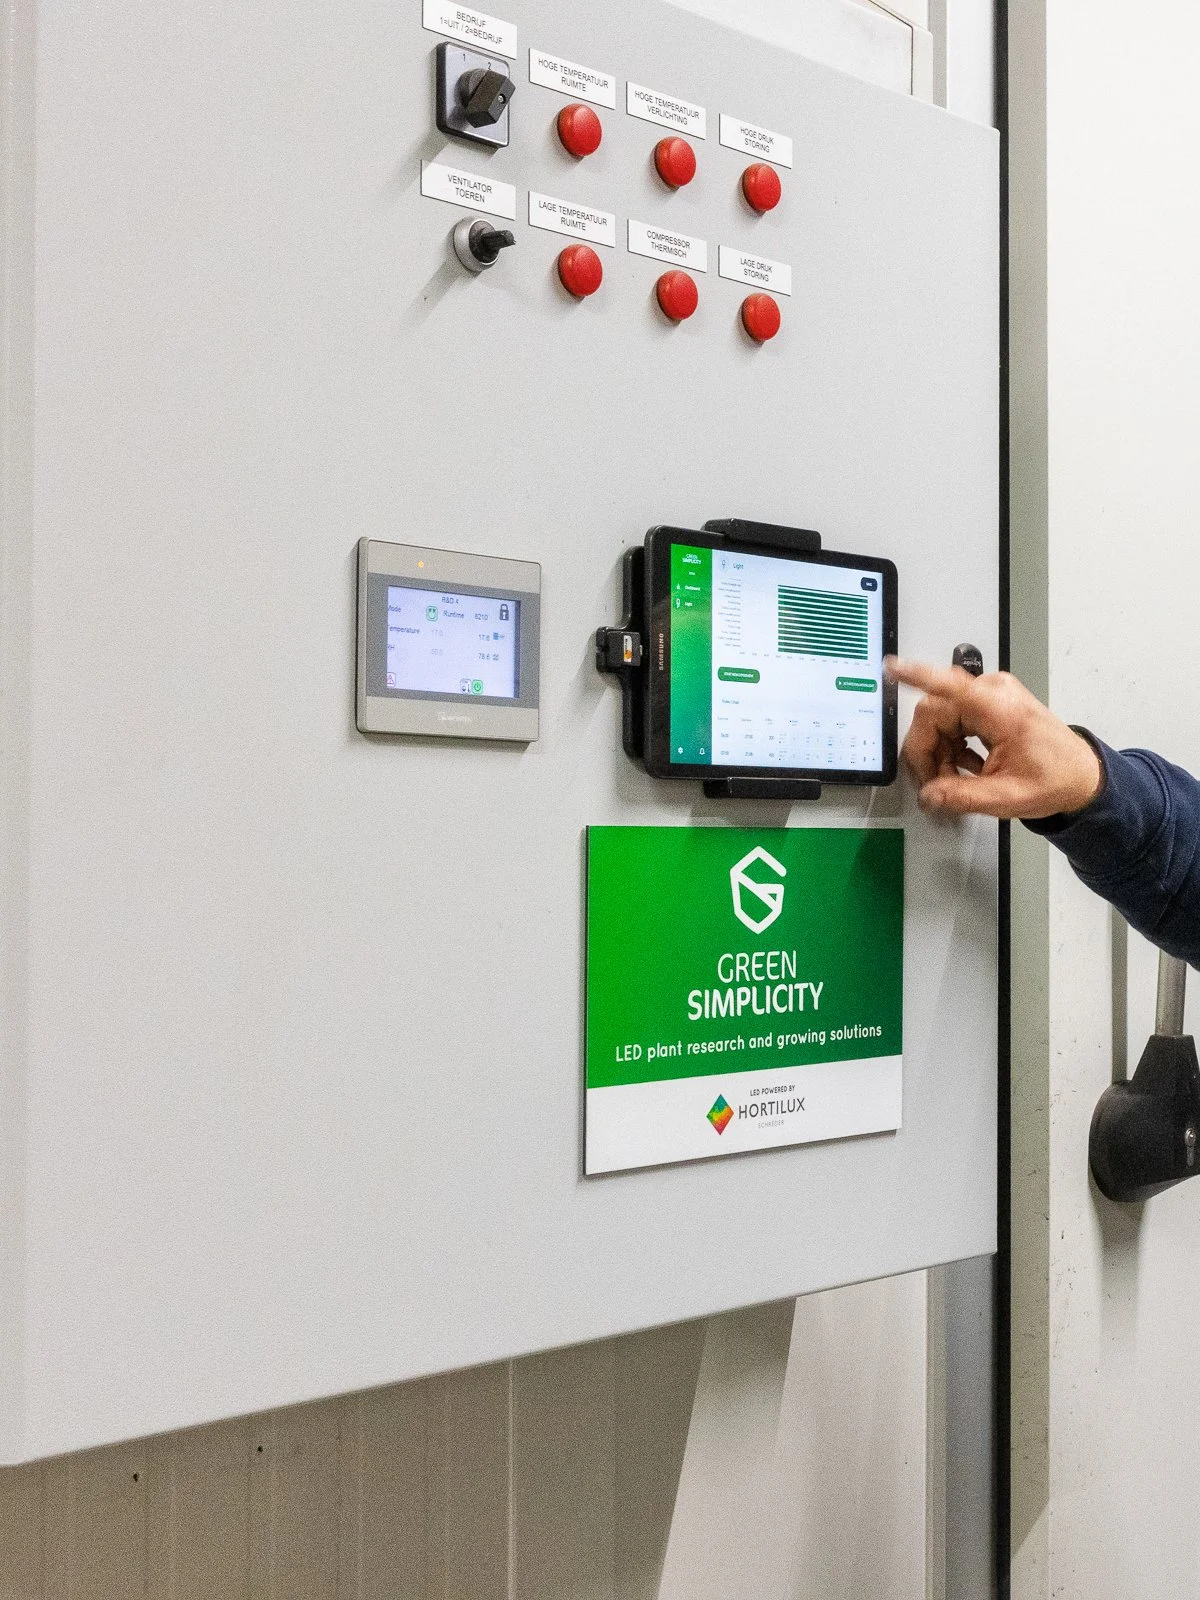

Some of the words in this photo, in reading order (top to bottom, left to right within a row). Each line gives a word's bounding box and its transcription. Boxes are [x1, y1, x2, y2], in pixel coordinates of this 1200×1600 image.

[456, 11, 487, 28] BEDRIJF
[538, 58, 558, 71] HOGE
[560, 66, 609, 89] TEMPERATUUR
[561, 76, 586, 92] RUIMTE
[634, 90, 653, 103] HOGE
[654, 96, 700, 119] TEMPERATUUR
[647, 105, 688, 126] VERLICHTING
[740, 126, 757, 139] HOGE
[744, 137, 770, 154] STORING
[448, 174, 492, 194] VENTILATOR
[455, 187, 485, 203] TOEREN
[538, 200, 557, 212] LAGE
[558, 205, 607, 226] TEMPERATUUR
[561, 217, 586, 231] RUIMTE
[646, 230, 690, 249] COMPRESSOR
[651, 241, 687, 259] THERMISCH
[740, 257, 756, 268] LAGE
[743, 268, 769, 282] STORING
[717, 950, 798, 983] GREEN
[687, 981, 824, 1020] SIMPLICITY
[615, 1045, 642, 1062] LED
[647, 1041, 683, 1063] plant
[686, 1034, 745, 1055] research
[748, 1032, 773, 1049] and
[777, 1028, 827, 1049] growing
[830, 1024, 883, 1041] solutions
[750, 1088, 761, 1097] LED
[761, 1085, 788, 1095] POWERED
[738, 1097, 806, 1119] HORTILUX
